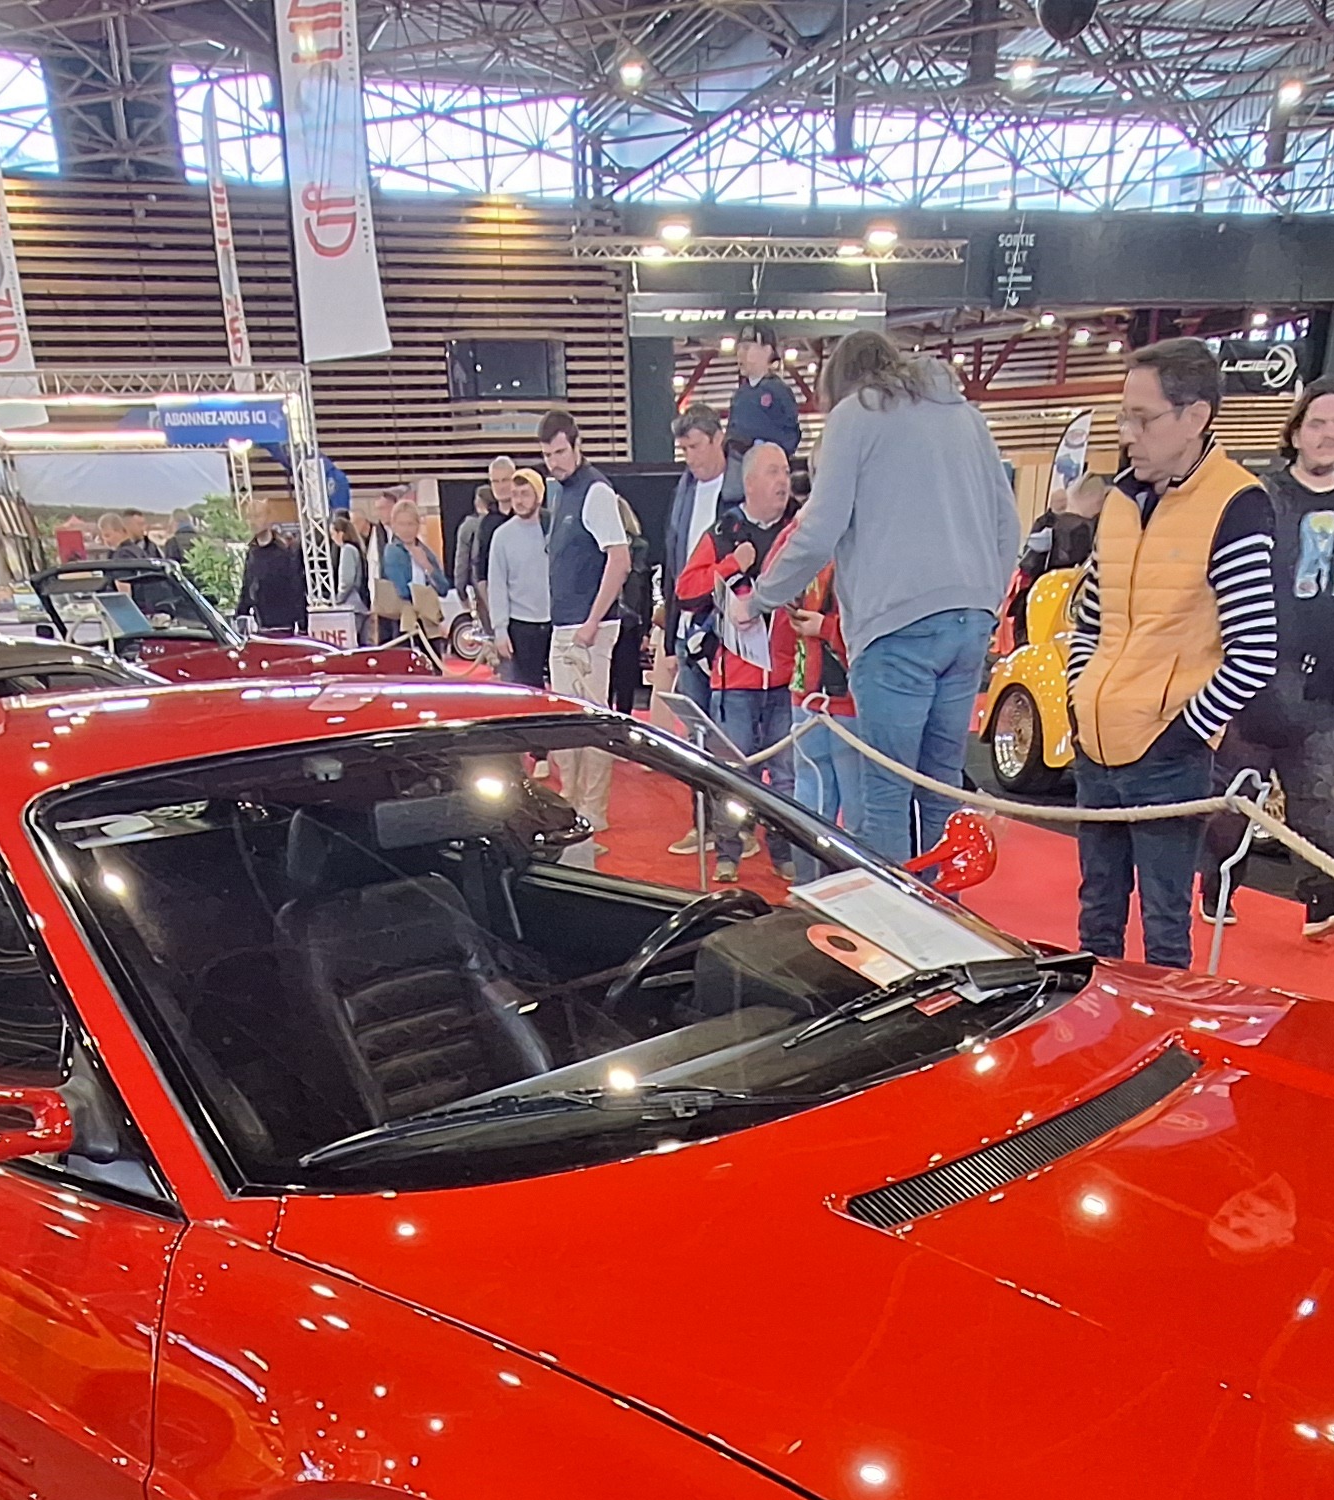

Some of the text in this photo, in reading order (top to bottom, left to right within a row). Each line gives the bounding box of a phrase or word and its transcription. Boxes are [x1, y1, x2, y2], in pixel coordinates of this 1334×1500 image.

[998, 233, 1036, 248] SORTIE
[661, 308, 860, 322] TRM GARAGE
[1220, 359, 1284, 372] LIGIER
[164, 409, 267, 427] ABONNEZ-VOUS ICI
